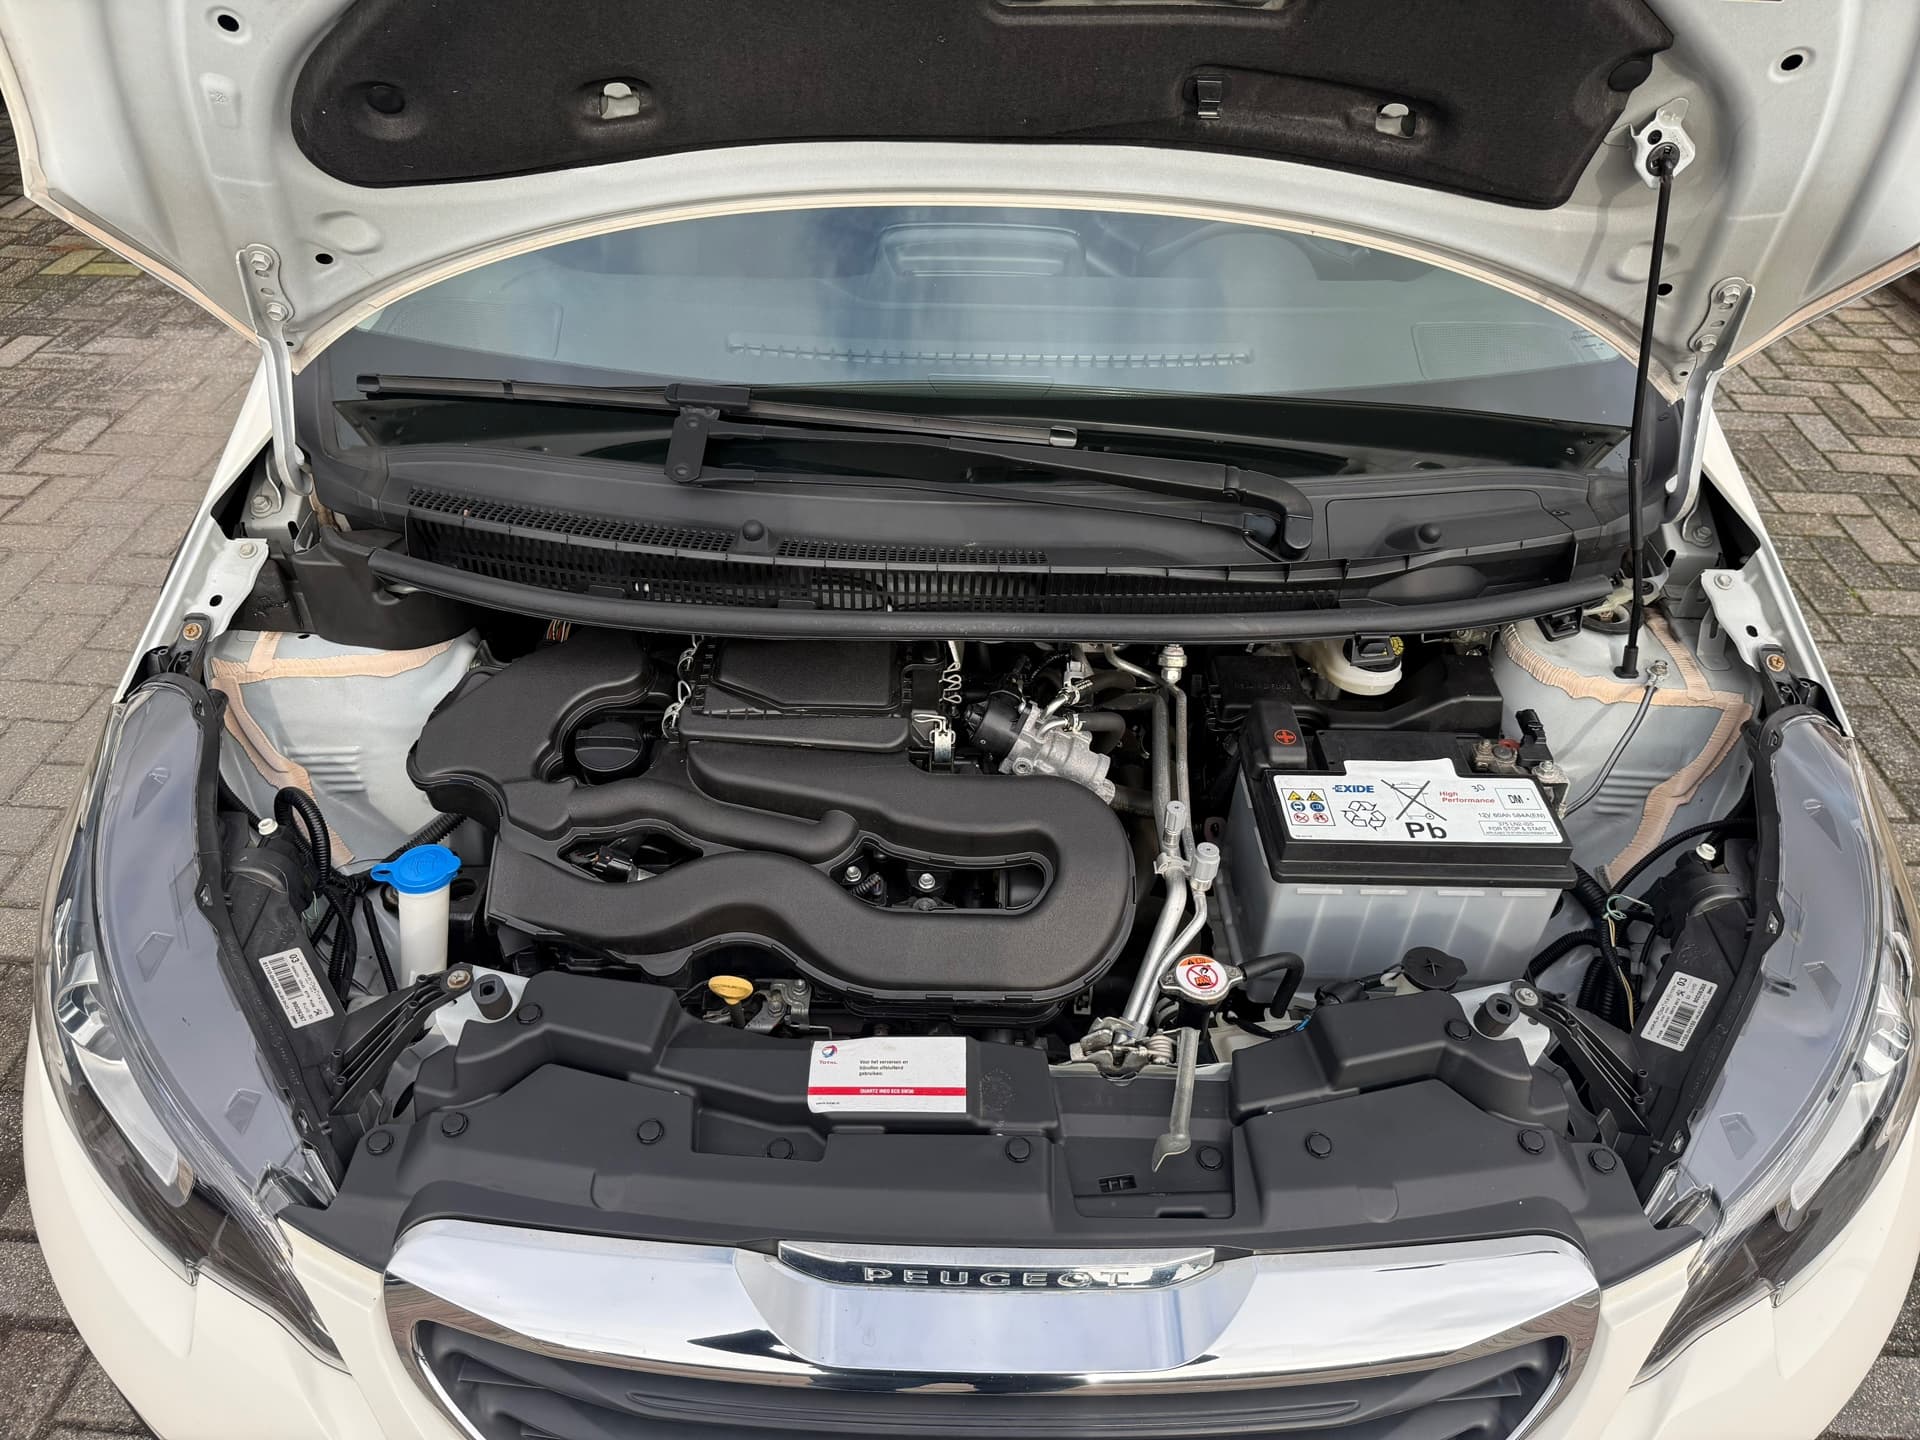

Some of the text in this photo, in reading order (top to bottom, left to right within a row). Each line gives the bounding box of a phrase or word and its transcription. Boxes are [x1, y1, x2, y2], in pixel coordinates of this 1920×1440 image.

[1333, 784, 1375, 794] EXIDE
[1405, 822, 1448, 839] Pb
[289, 953, 300, 963] 03
[1676, 977, 1687, 987] 03
[863, 1267, 1131, 1288] PEUGEOT
